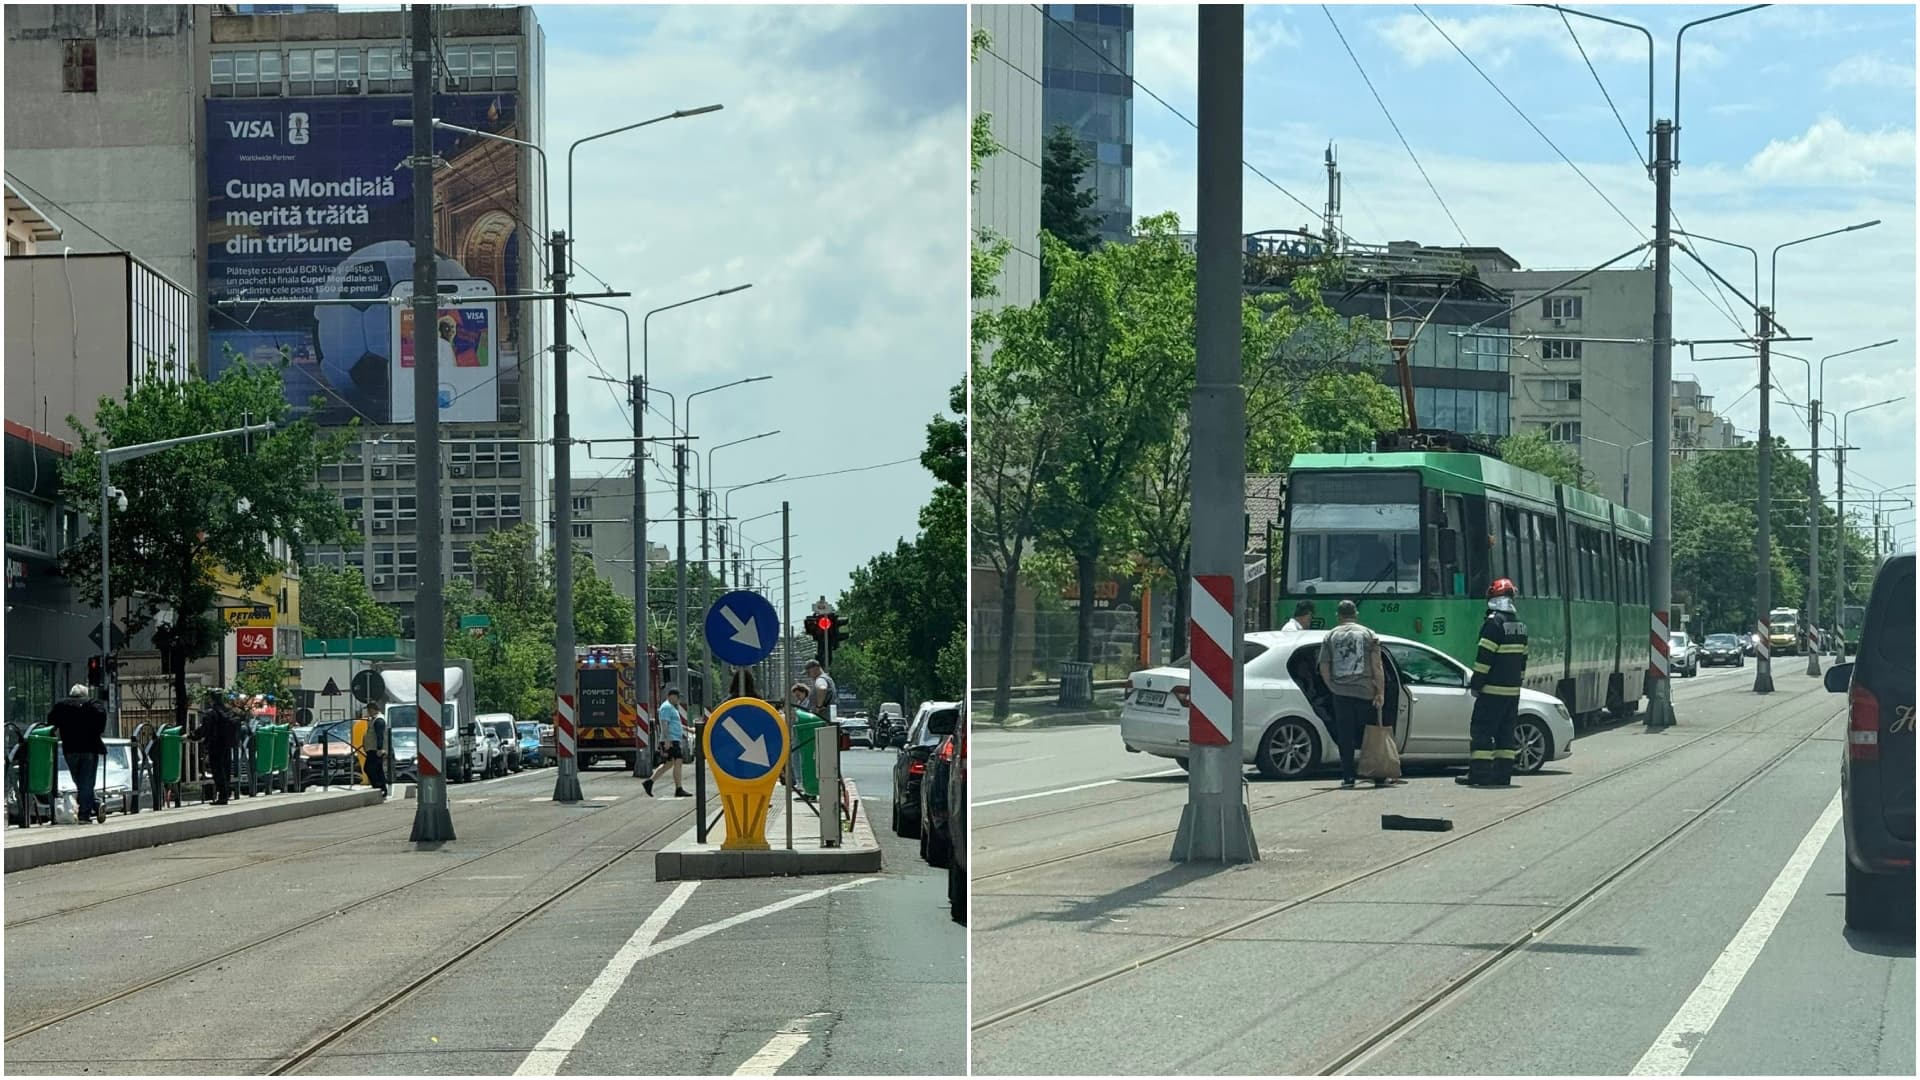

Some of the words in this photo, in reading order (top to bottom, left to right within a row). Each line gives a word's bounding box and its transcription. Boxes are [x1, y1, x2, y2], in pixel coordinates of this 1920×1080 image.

[225, 121, 275, 138] VISA
[272, 153, 296, 161] Partner
[226, 179, 285, 202] Cupa
[289, 176, 395, 198] Mondială
[226, 205, 302, 226] merită
[306, 204, 369, 225] trăită
[226, 234, 263, 254] din
[267, 233, 352, 253] tribune
[272, 265, 298, 274] cardul
[300, 265, 317, 273] BCR
[269, 276, 276, 284] la
[277, 275, 299, 284] finala
[272, 286, 289, 294] cele
[290, 286, 313, 295] peste
[466, 311, 485, 320] VISA
[1380, 602, 1400, 613] 268
